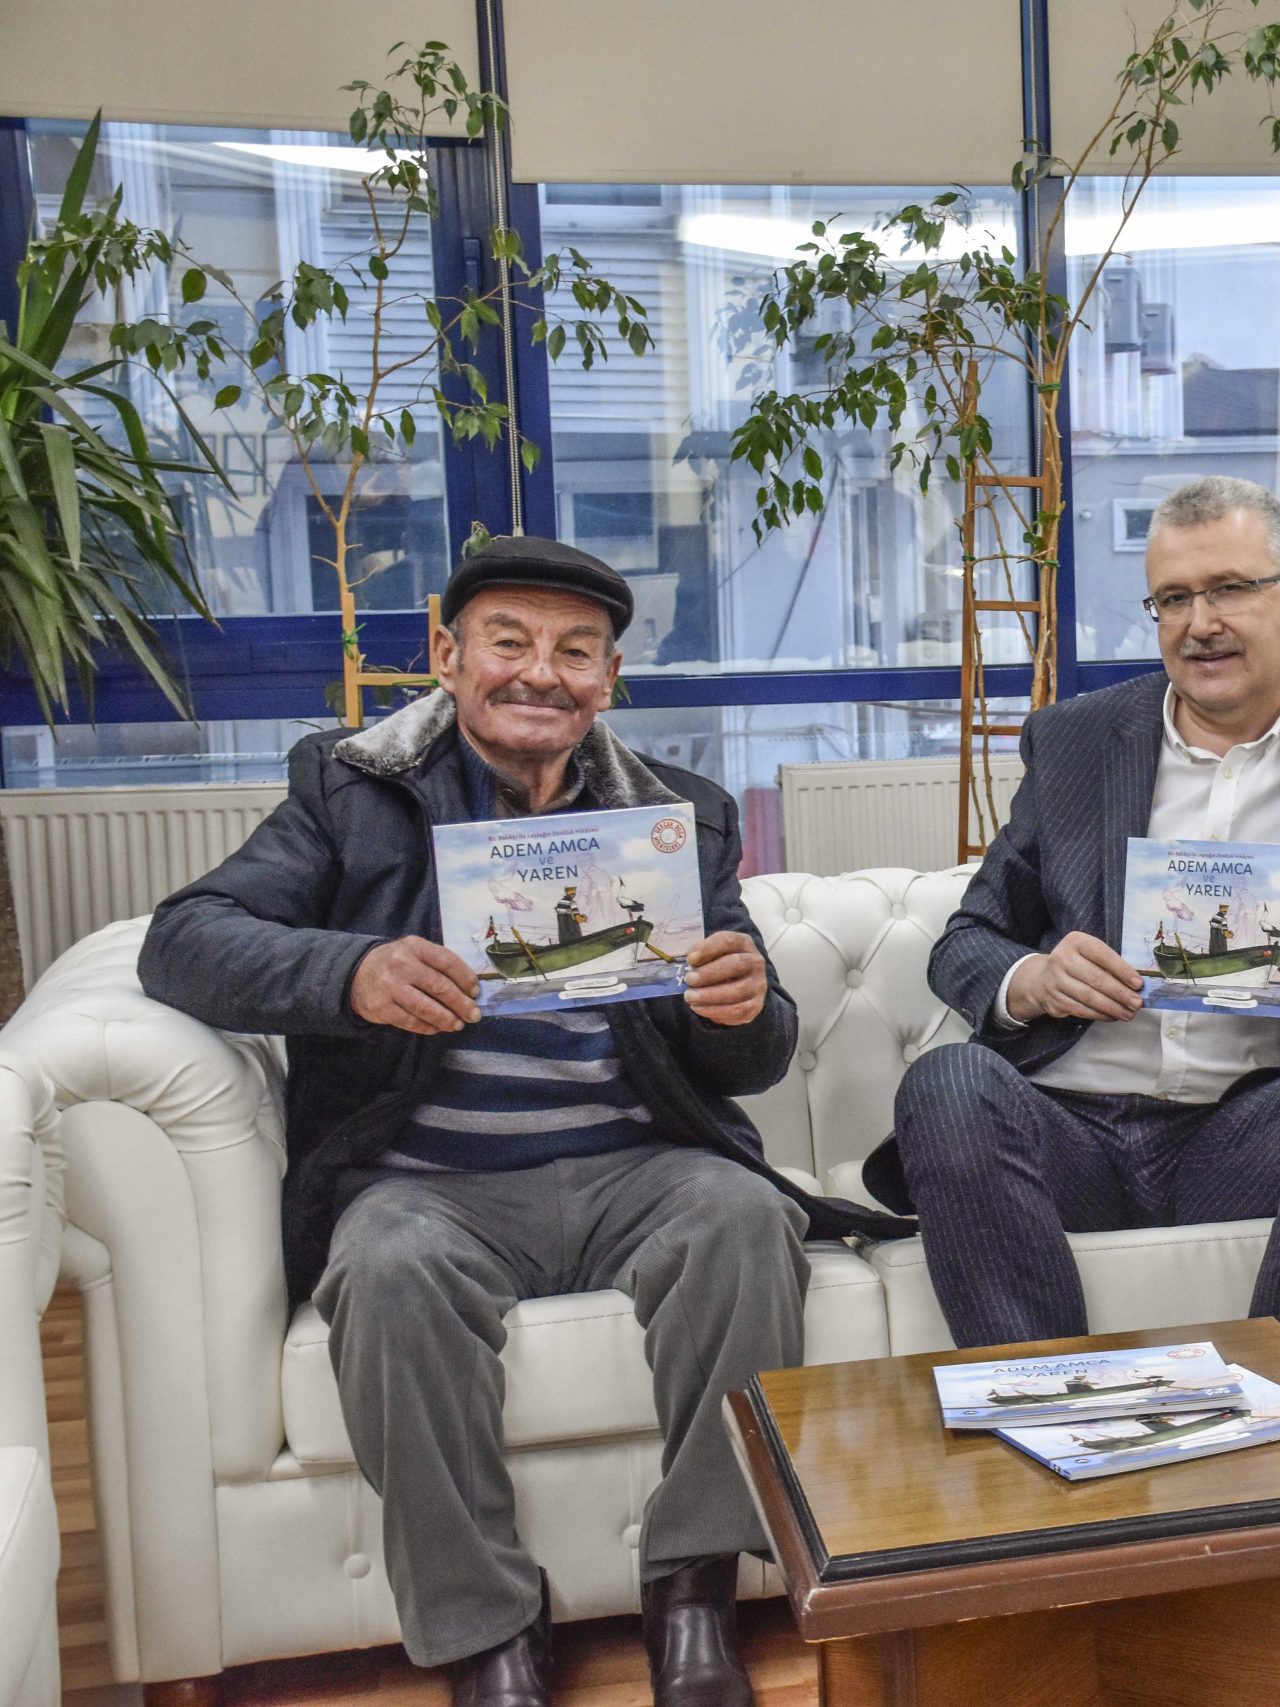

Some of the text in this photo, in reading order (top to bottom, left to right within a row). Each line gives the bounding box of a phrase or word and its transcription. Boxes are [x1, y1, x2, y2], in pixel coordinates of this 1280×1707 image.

[490, 838, 600, 858] ADEM AMCA
[538, 856, 554, 865] ve
[1168, 860, 1252, 875] ADEM AMCA
[517, 865, 578, 882] YAREN
[1186, 884, 1232, 897] YAREN
[1055, 1359, 1111, 1368] AMCA
